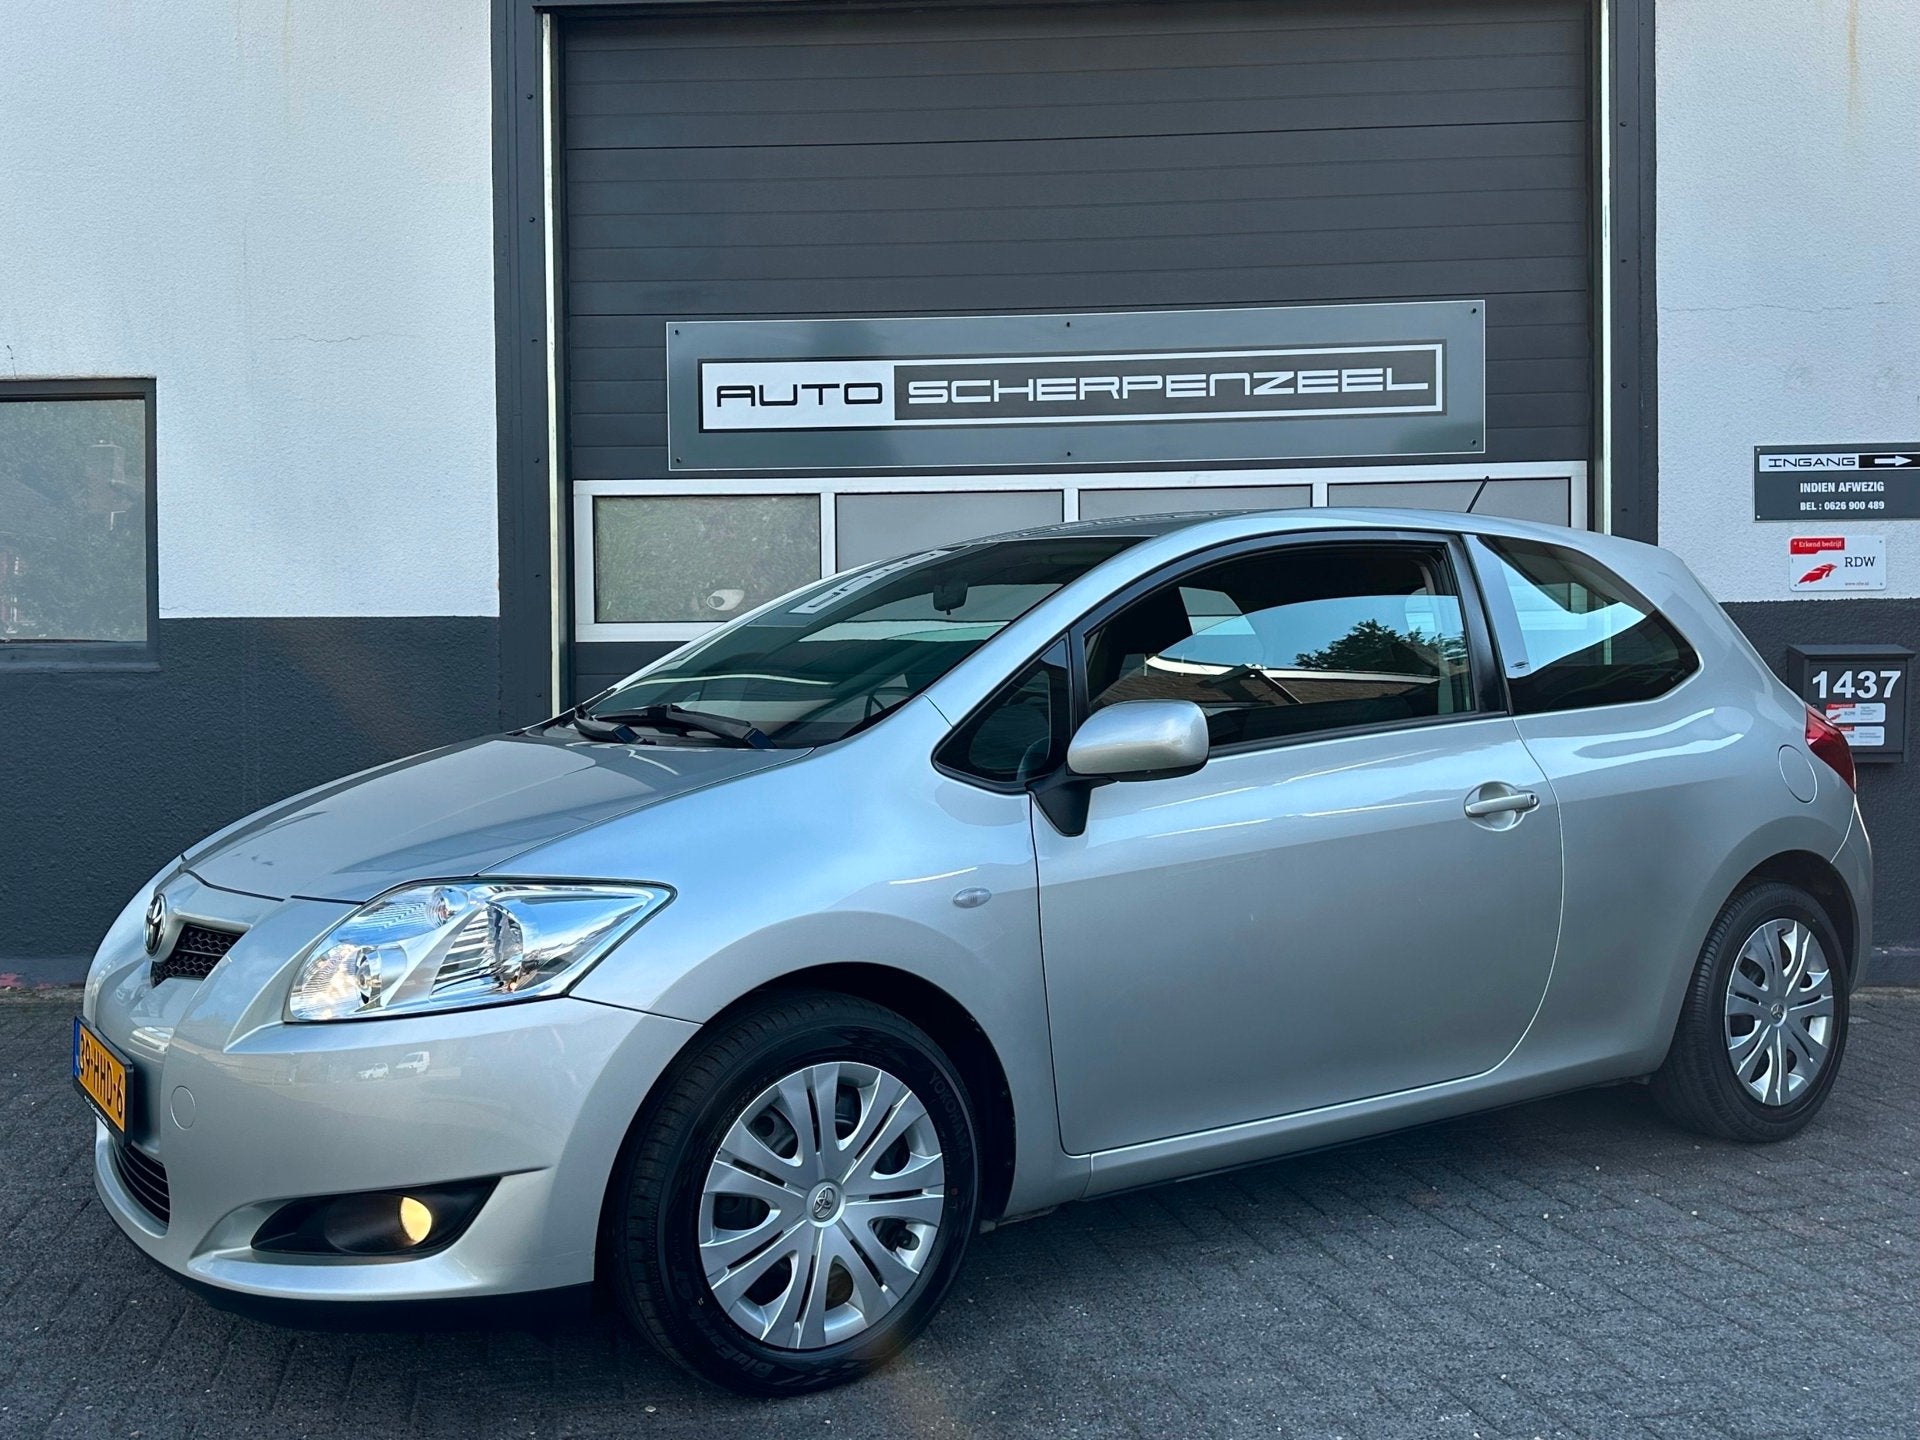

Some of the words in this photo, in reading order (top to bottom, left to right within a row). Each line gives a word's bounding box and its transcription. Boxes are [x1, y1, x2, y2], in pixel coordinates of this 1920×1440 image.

[716, 382, 883, 408] AUTO
[907, 367, 1429, 405] SCHERPENZEEL
[1768, 457, 1856, 468] INGANG
[1800, 482, 1836, 493] INDIEN
[1838, 481, 1885, 493] AFWEZIG
[1800, 501, 1817, 511] BEL
[1824, 501, 1847, 511] 0626
[1848, 501, 1866, 510] 900
[1867, 500, 1885, 510] 489
[1799, 540, 1821, 548] Erkend
[1822, 540, 1842, 549] bedrijf
[1844, 556, 1876, 568] RDW
[1812, 670, 1902, 699] 1437
[79, 1033, 124, 1119] 39-HHD-6
[927, 1069, 971, 1161] YOKOHAMA
